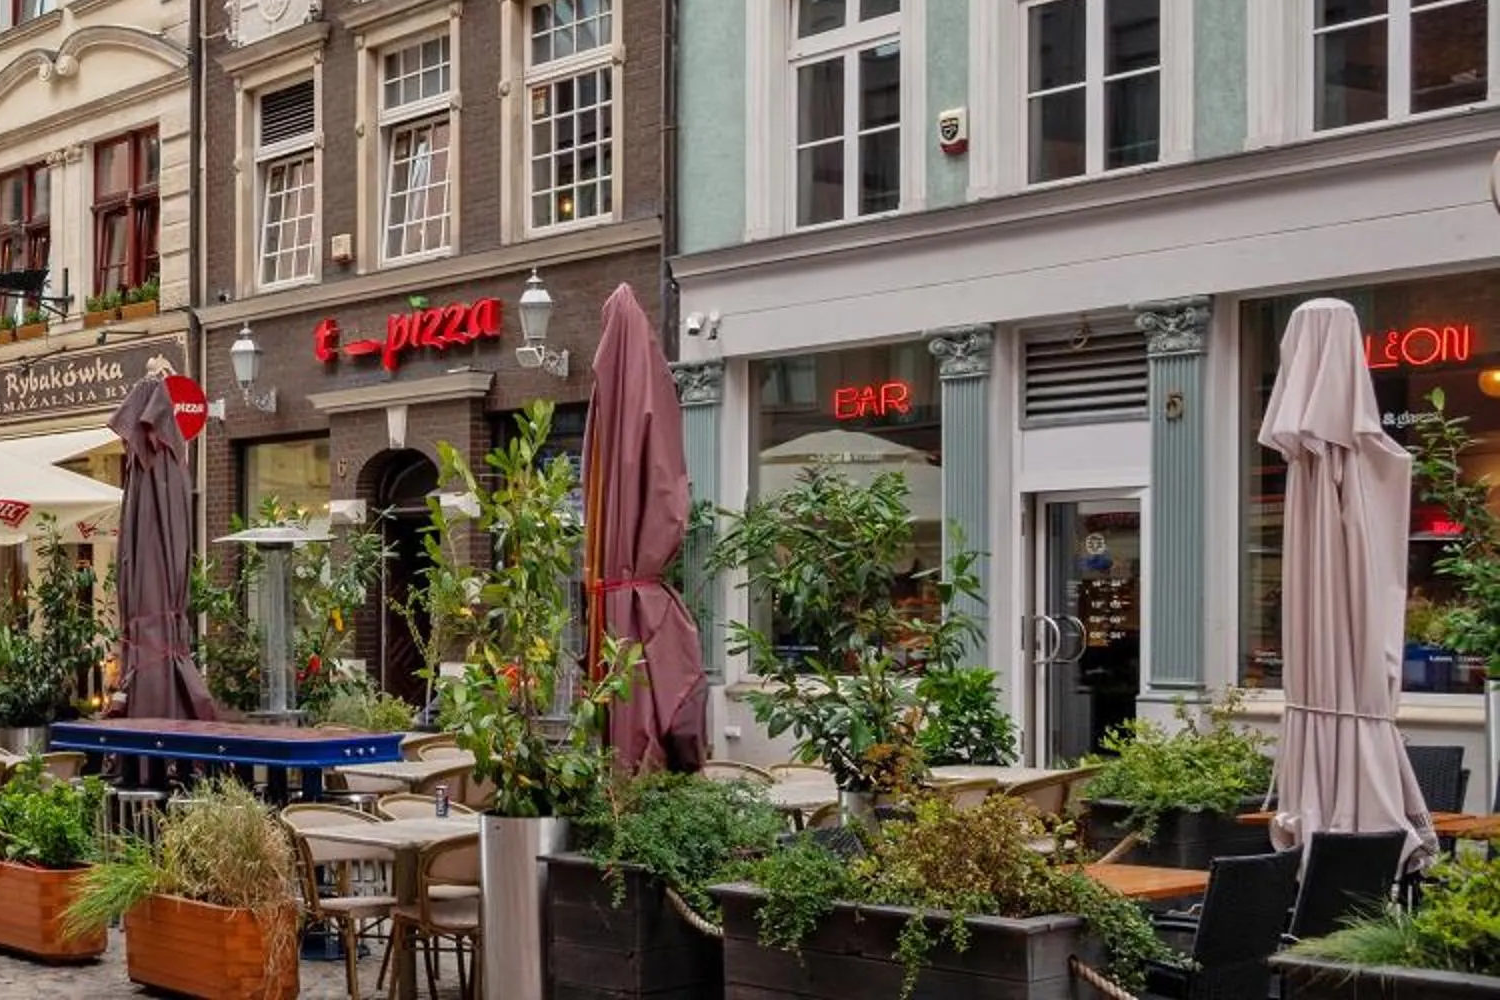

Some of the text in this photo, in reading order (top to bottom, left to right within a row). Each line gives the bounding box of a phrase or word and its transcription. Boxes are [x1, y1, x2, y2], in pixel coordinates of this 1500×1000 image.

[1364, 324, 1470, 369] LEON
[5, 358, 123, 399] Rybakówka
[105, 382, 137, 399] RY
[173, 402, 205, 417] pizza
[835, 382, 911, 420] BAR
